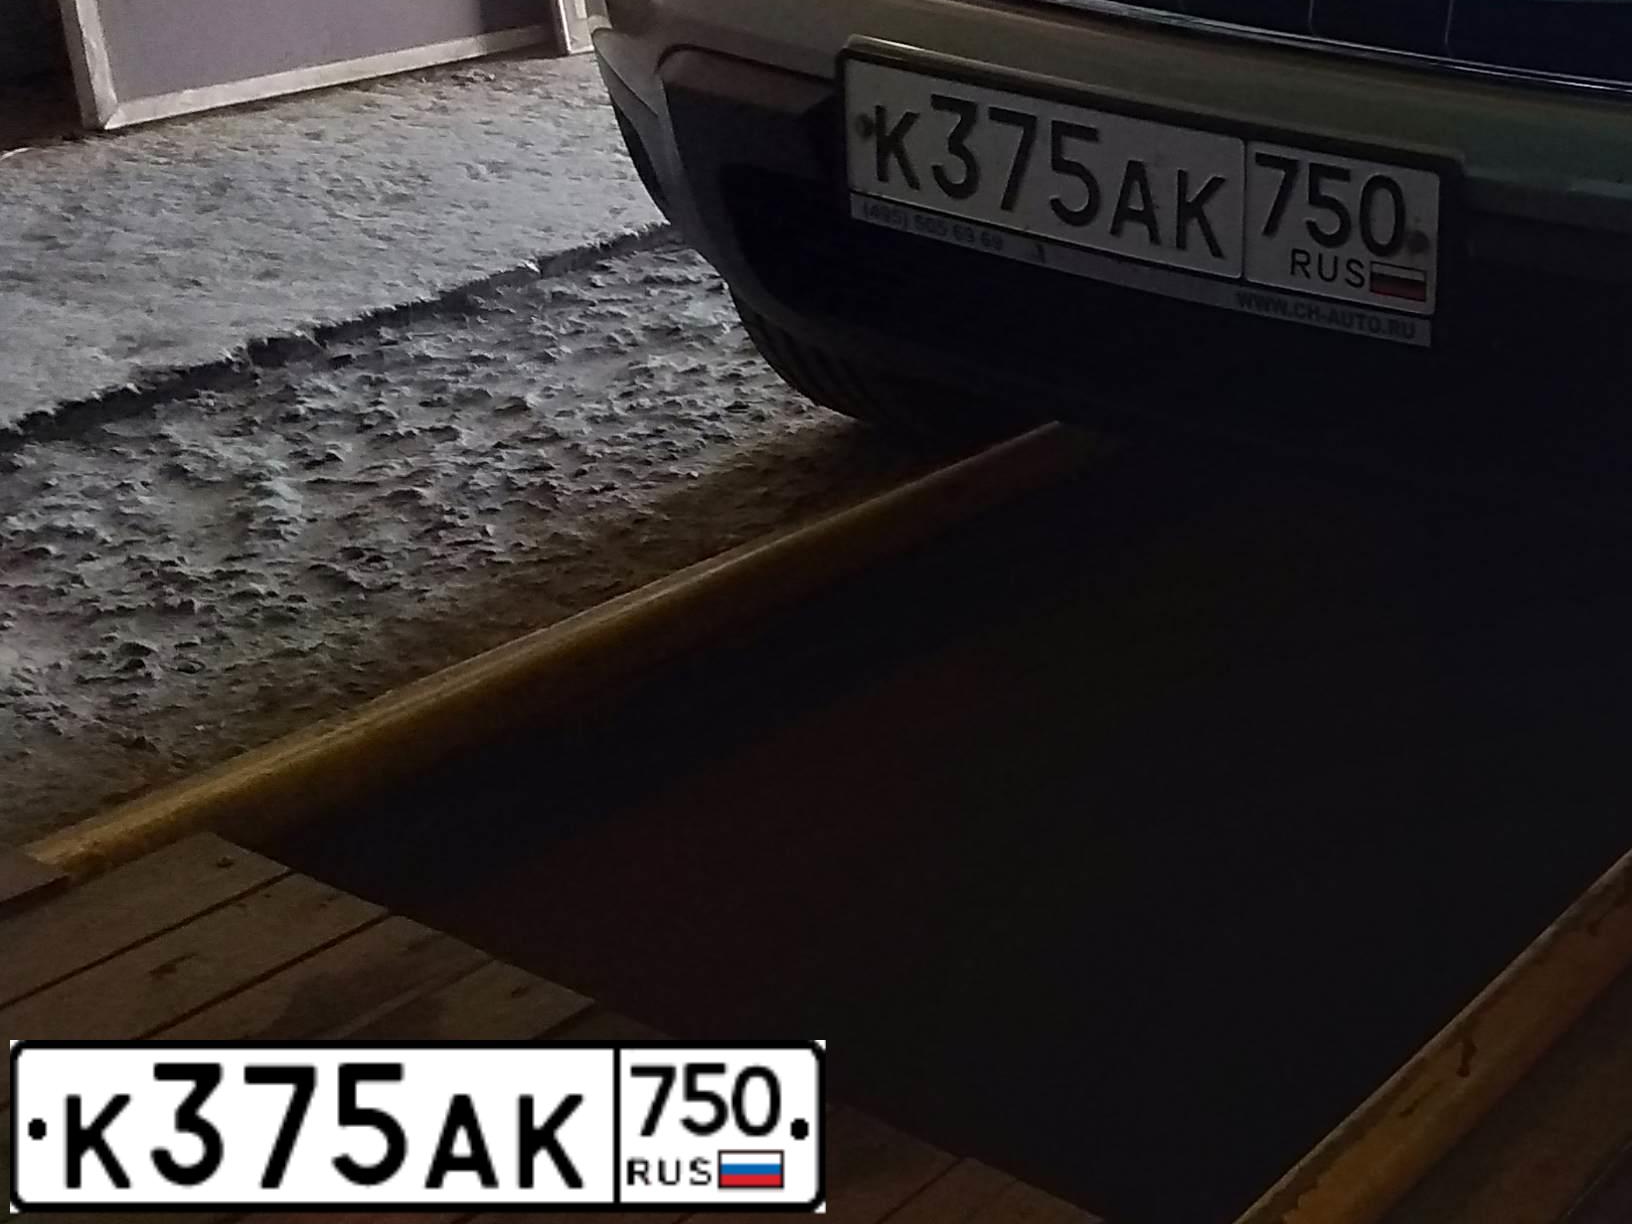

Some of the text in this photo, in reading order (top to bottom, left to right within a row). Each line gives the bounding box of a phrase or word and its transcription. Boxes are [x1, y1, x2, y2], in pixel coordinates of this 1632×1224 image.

[873, 94, 1407, 261] К375АК 750
[1290, 248, 1365, 289] RUS
